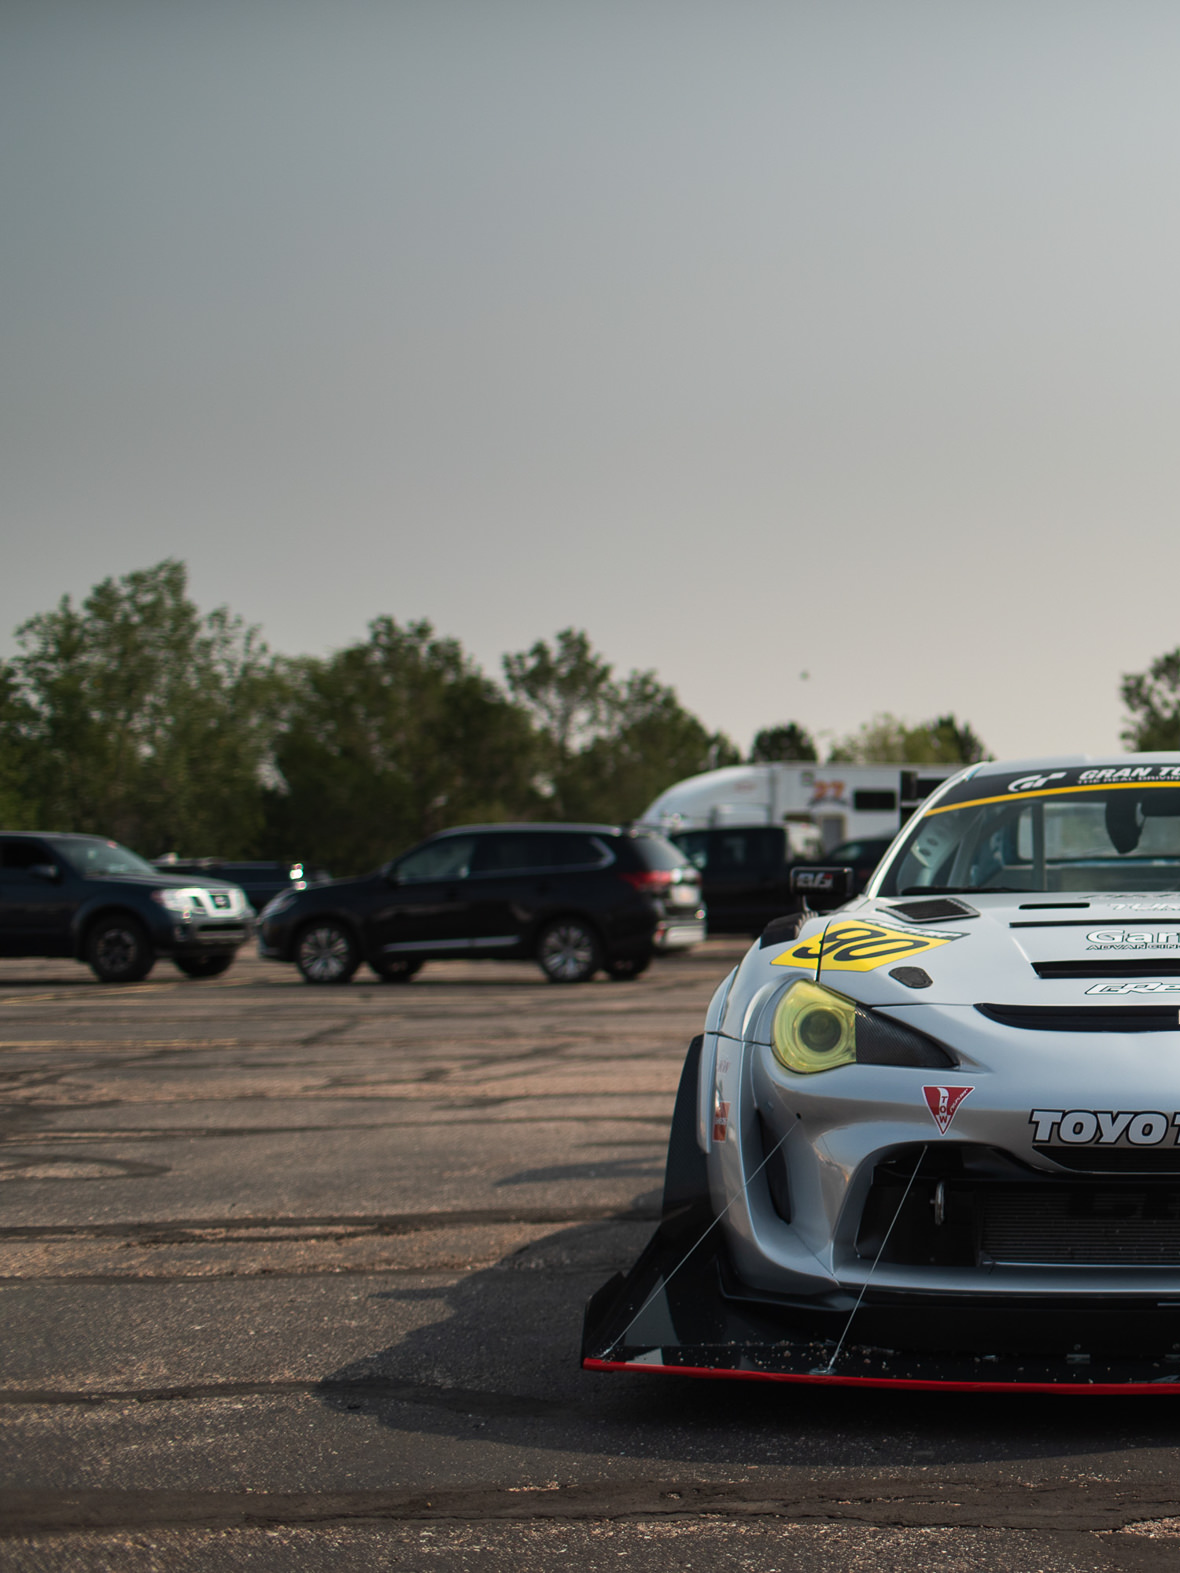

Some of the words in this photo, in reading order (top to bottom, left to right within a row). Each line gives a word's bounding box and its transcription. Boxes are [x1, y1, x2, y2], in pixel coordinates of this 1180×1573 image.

[1079, 767, 1152, 780] GRAN
[792, 927, 930, 962] 90
[939, 1096, 948, 1124] TOW
[1029, 1109, 1168, 1146] TOYO
